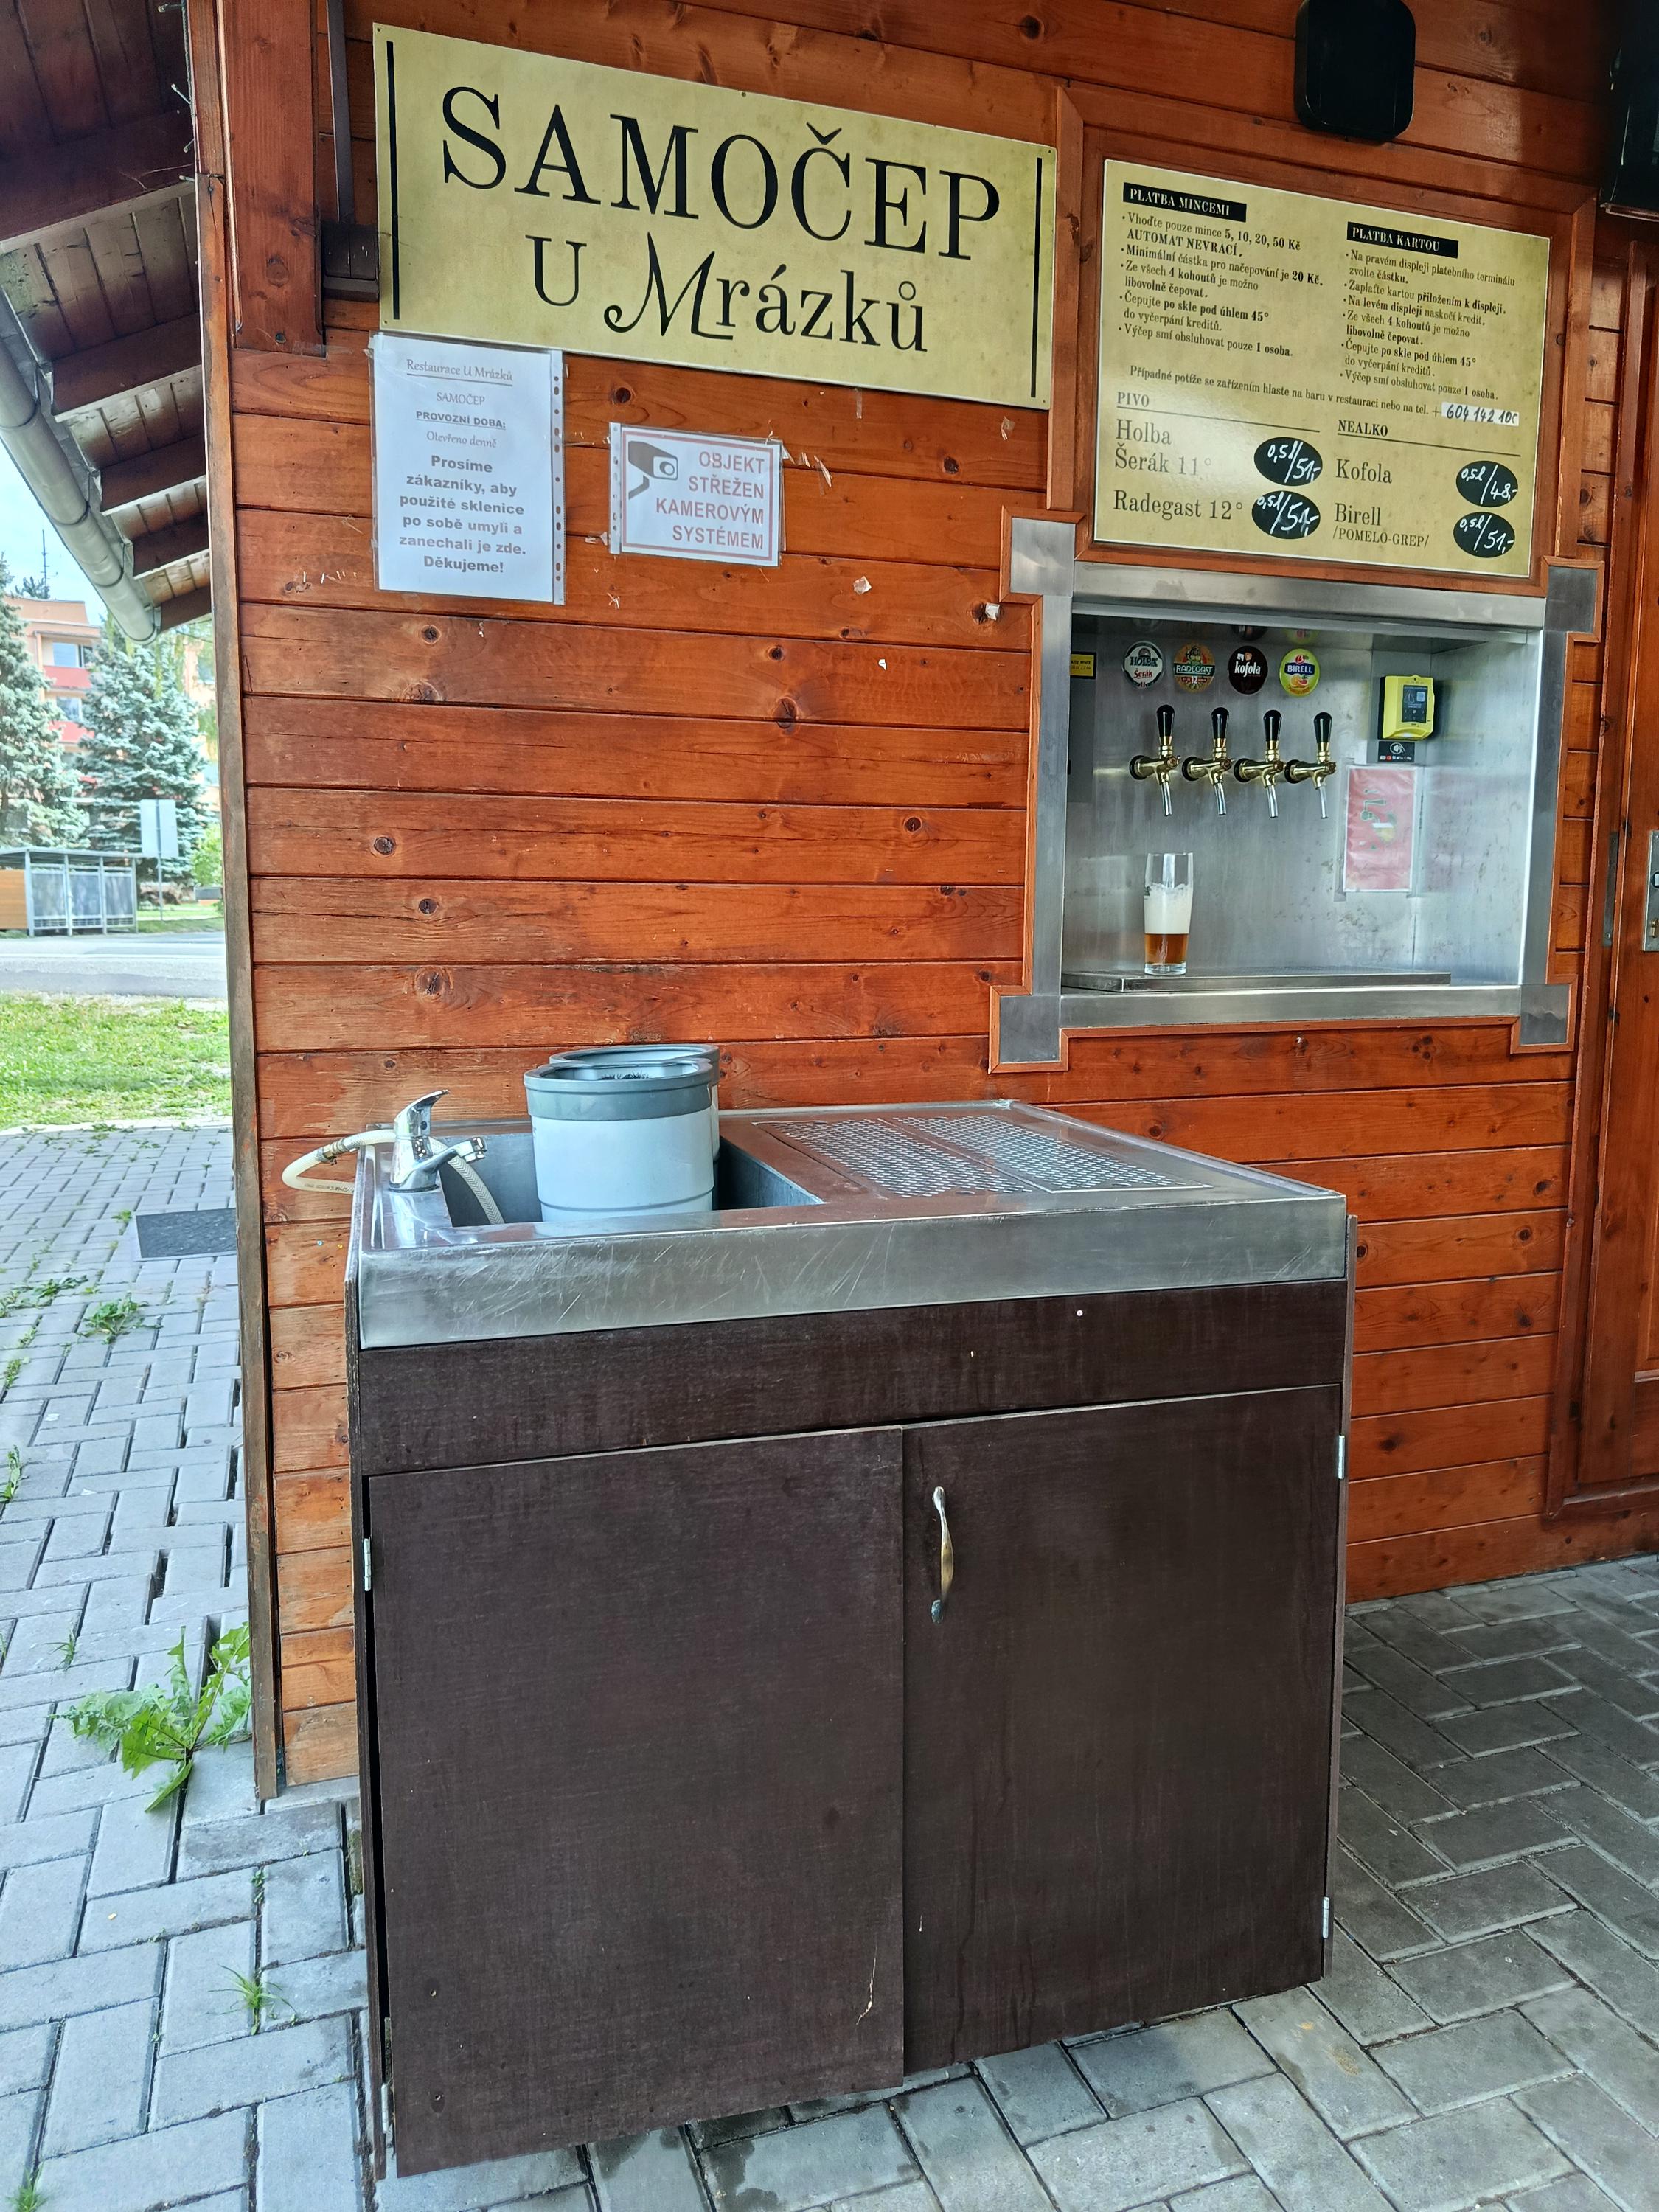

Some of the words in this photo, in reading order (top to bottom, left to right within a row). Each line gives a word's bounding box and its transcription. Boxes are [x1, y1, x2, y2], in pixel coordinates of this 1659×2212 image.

[442, 86, 1001, 262] SAMOČEP
[1130, 188, 1175, 207] PLATBA
[1178, 197, 1231, 216] MINCEMI
[1127, 229, 1183, 246] AUTOMAT
[1186, 238, 1243, 257] NEVRACÍ.
[1128, 212, 1162, 228] Vhoďte
[1165, 220, 1192, 236] pouze
[1195, 226, 1221, 238] mince
[1225, 229, 1234, 241] 5,
[1238, 232, 1251, 244] 10,
[1255, 233, 1270, 247] 20,
[1273, 236, 1284, 248] 50
[1288, 239, 1301, 251] Kč
[1352, 227, 1393, 243] PLATBA
[1397, 235, 1439, 251] KARTOU
[1125, 260, 1138, 272] Ze
[1141, 263, 1166, 276] všech
[1169, 267, 1175, 277] 4
[1178, 269, 1216, 283] kohoutů
[1217, 275, 1227, 287] je
[1230, 279, 1258, 291] možno
[1126, 244, 1175, 262] Minimální
[1178, 253, 1208, 267] částka
[1211, 260, 1225, 271] pro
[1228, 262, 1279, 279] načepování
[1280, 271, 1289, 282] je
[1292, 271, 1304, 282] 20
[1307, 273, 1323, 286] Kč.
[1349, 267, 1374, 279] zvolte
[1377, 271, 1408, 284] částku.
[1351, 249, 1363, 261] Na
[1366, 254, 1397, 267] pravém
[1399, 258, 1429, 273] displeji
[1432, 265, 1474, 279] platebního
[1477, 271, 1514, 286] terminálu
[526, 234, 587, 307] U
[604, 232, 929, 354] Mrázků
[1125, 276, 1166, 292] libovolně
[1169, 282, 1208, 298] čepovat.
[1349, 279, 1385, 295] Zaplaťte
[1387, 288, 1414, 300] kartou
[1417, 293, 1461, 307] přiložením
[1464, 299, 1470, 308] k
[1472, 299, 1506, 314] displeji.
[1124, 291, 1160, 307] Čepujte
[1164, 299, 1175, 310] po
[1178, 300, 1197, 311] skle
[1200, 304, 1217, 316] pod
[1220, 306, 1248, 319] úhlem
[1251, 310, 1269, 321] 45°
[1348, 295, 1360, 307] Na
[1363, 298, 1388, 311] levém
[1391, 302, 1422, 317] displeji
[1425, 308, 1455, 321] naskočí
[1458, 313, 1485, 326] kredit.
[1124, 309, 1135, 319] do
[1138, 311, 1183, 327] vyčerpání
[1186, 317, 1222, 331] kreditů.
[1347, 310, 1358, 320] Ze
[1361, 313, 1385, 325] všech
[1388, 316, 1392, 326] 4
[1396, 317, 1430, 332] kohoutů
[1433, 324, 1441, 335] je
[1444, 326, 1470, 338] možno
[1125, 324, 1152, 338] Výčep
[1156, 329, 1172, 340] smí
[1175, 331, 1224, 347] obsluhovat
[1227, 339, 1252, 351] pouze
[1256, 342, 1260, 352] 1
[1265, 344, 1293, 357] osoba.
[1346, 325, 1385, 339] libovolně
[1388, 329, 1423, 345] čepovat.
[1346, 338, 1379, 354] Čepujte
[1381, 347, 1391, 357] po
[1394, 347, 1411, 358] skle
[1414, 349, 1429, 361] pod
[1432, 352, 1457, 366] úhlem
[1460, 357, 1476, 367] 45°
[407, 359, 460, 375] Restaurace
[464, 366, 472, 376] U
[475, 368, 513, 382] Mrázků
[1345, 355, 1355, 366] do
[1358, 358, 1399, 372] vyčerpání
[1401, 363, 1435, 376] kreditů.
[1130, 365, 1172, 381] Případné
[1175, 373, 1202, 385] potíže
[1204, 378, 1214, 386] se
[1217, 378, 1259, 393] zařízením
[1263, 383, 1289, 396] hlaste
[1292, 388, 1303, 397] na
[1305, 389, 1326, 401] baru
[1336, 394, 1379, 408] restauraci
[1381, 401, 1401, 411] nebo
[1403, 404, 1413, 413] na
[1416, 404, 1429, 414] tel.
[1345, 370, 1371, 385] Výčep
[1373, 375, 1388, 385] smí
[1391, 376, 1435, 392] obsluhovat
[1438, 383, 1461, 395] pouze
[1464, 386, 1469, 395] 1
[1472, 387, 1498, 400] osoba.
[436, 392, 485, 406] SAMOČEP
[1116, 391, 1150, 407] PIVO
[416, 411, 470, 424] PROVOZNÍ
[474, 417, 506, 428] DOBA:
[1447, 404, 1469, 422] 604
[1474, 407, 1494, 422] 142
[427, 431, 467, 444] Otevřeno
[470, 439, 497, 448] denně
[1116, 420, 1172, 445] Holba
[1338, 420, 1388, 437] NEALKO
[431, 455, 493, 473] Prosíme
[700, 451, 765, 474] OBJEKT
[1115, 442, 1169, 473] Šerák
[1178, 456, 1211, 476] 11°
[1336, 459, 1392, 484] Kofola
[407, 474, 485, 495] zákazníky,
[490, 484, 517, 497] aby
[689, 474, 764, 499] STŘEŽEN
[400, 495, 456, 509] použité
[461, 500, 524, 515] sklenice
[656, 498, 763, 524] KAMEROVÝM
[1113, 490, 1201, 521] Radegast
[1209, 500, 1242, 520] 12°
[1335, 503, 1381, 526] Birell
[403, 516, 421, 528] po
[426, 517, 462, 529] sobě
[468, 521, 508, 535] umyli
[514, 525, 522, 535] a
[673, 525, 763, 549] SYSTÉMEM
[1333, 526, 1429, 547] /POMELO-GREP/
[399, 536, 472, 550] zanechali
[477, 541, 491, 554] je
[496, 543, 526, 554] zde.
[424, 555, 504, 573] Děkujeme!
[1130, 657, 1156, 667] HOLBA
[1133, 668, 1153, 679] Šerák
[1176, 665, 1213, 675] RADEGAST
[1234, 661, 1261, 677] kofola
[1287, 665, 1312, 673] BIRELL
[1192, 675, 1197, 684] 12
